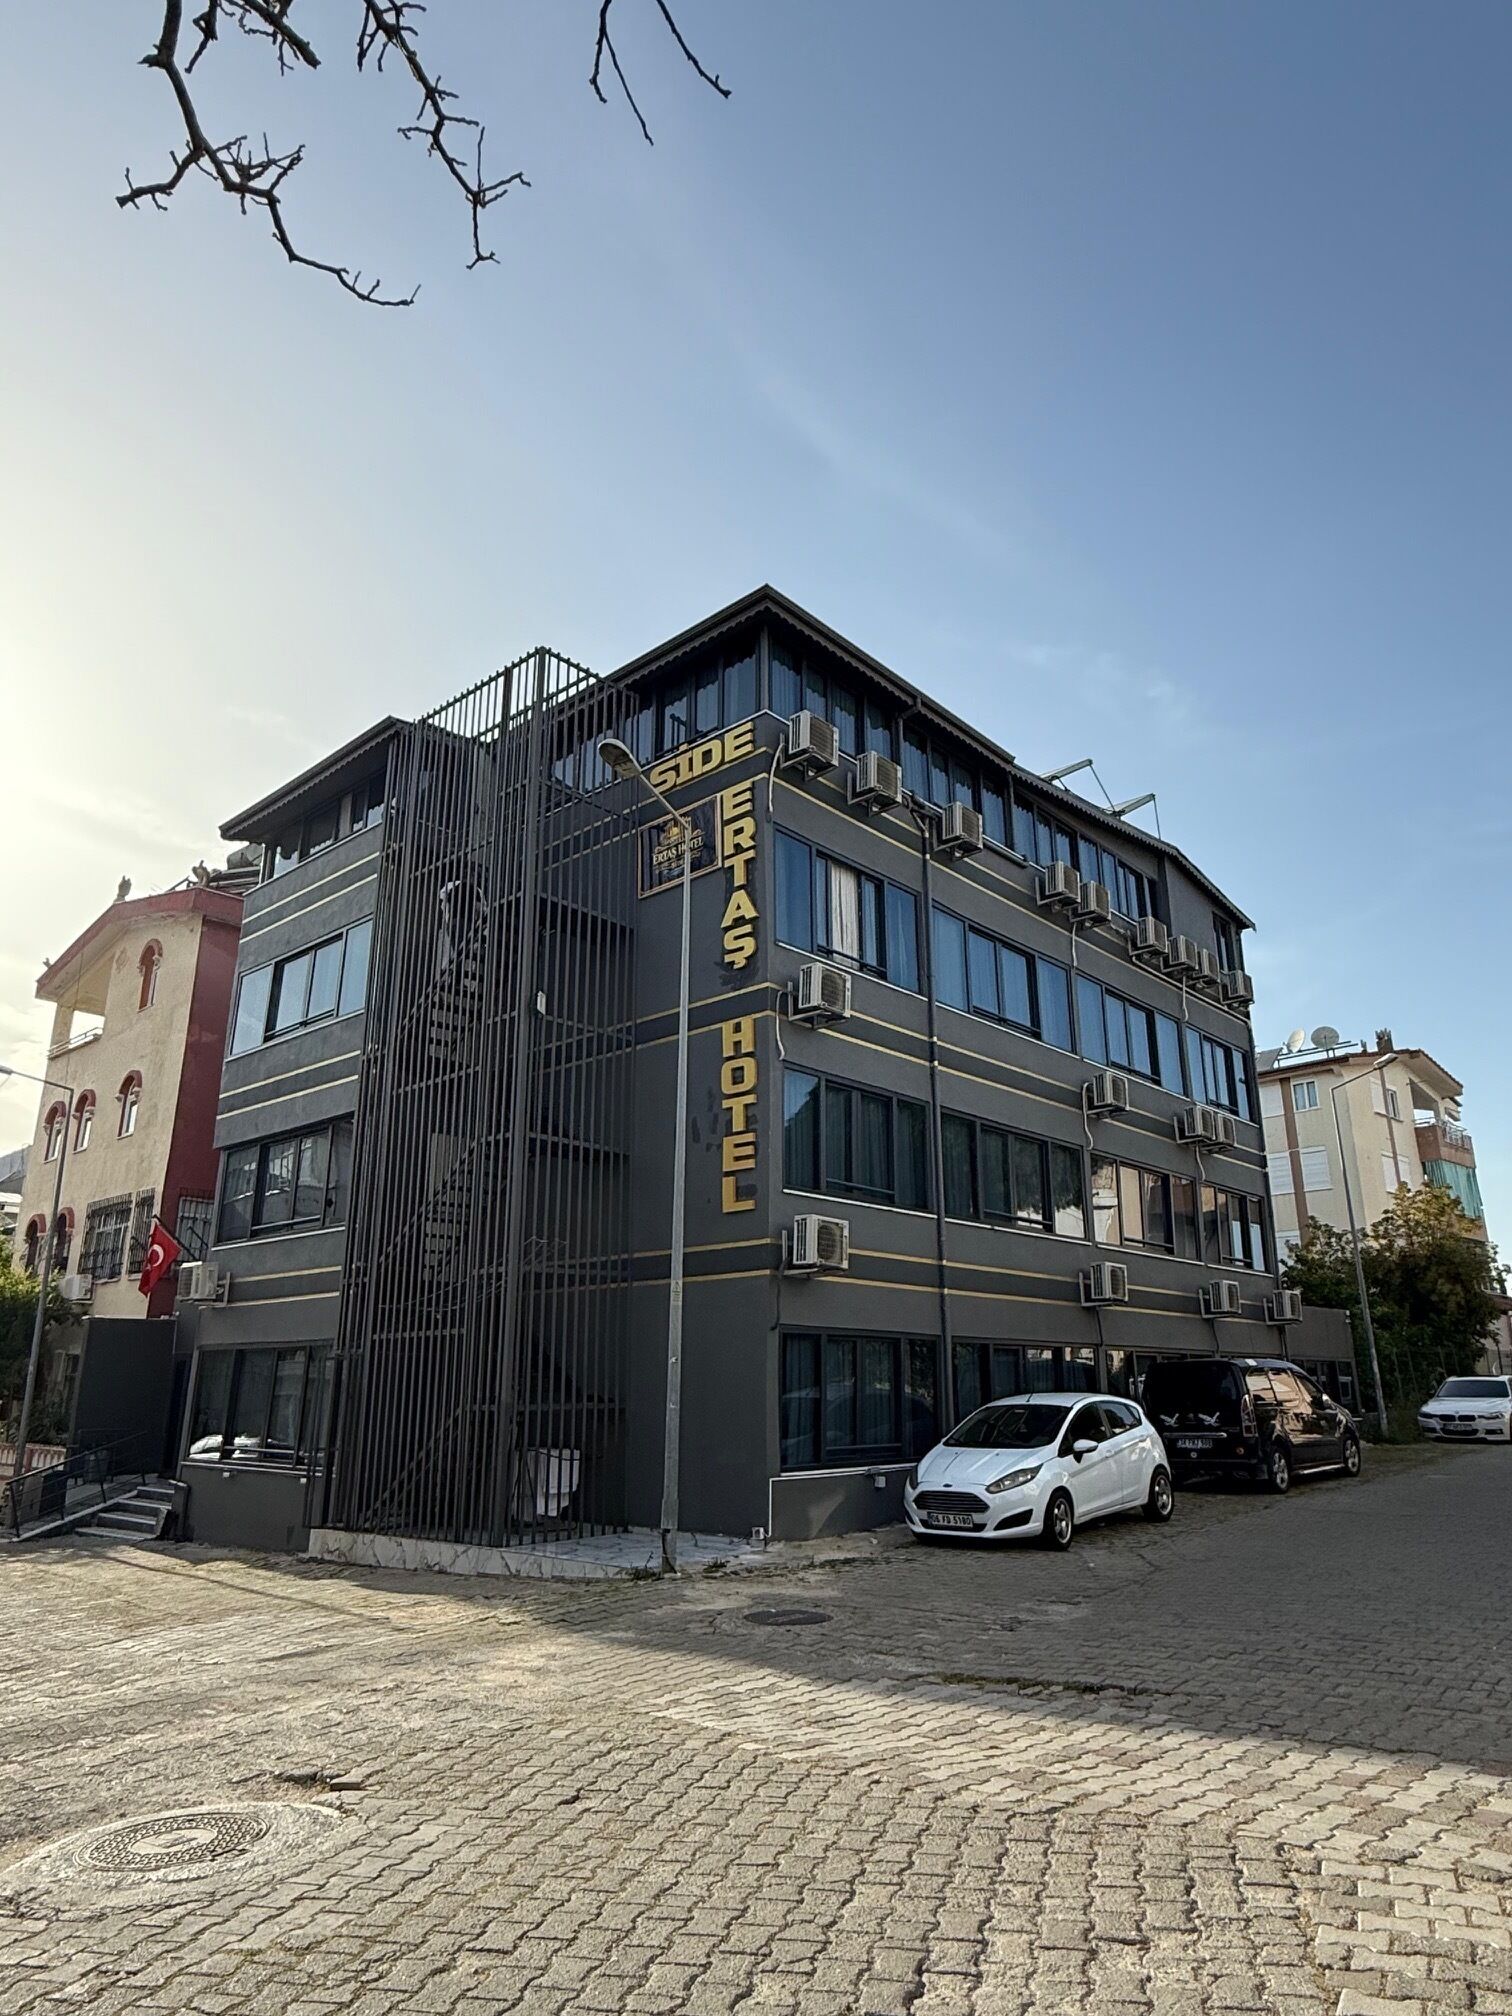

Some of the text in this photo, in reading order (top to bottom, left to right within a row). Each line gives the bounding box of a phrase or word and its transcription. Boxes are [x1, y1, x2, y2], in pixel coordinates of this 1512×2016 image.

[678, 836, 704, 855] HTEL
[721, 779, 759, 969] ERTAŞ
[721, 1017, 758, 1213] HOTEL
